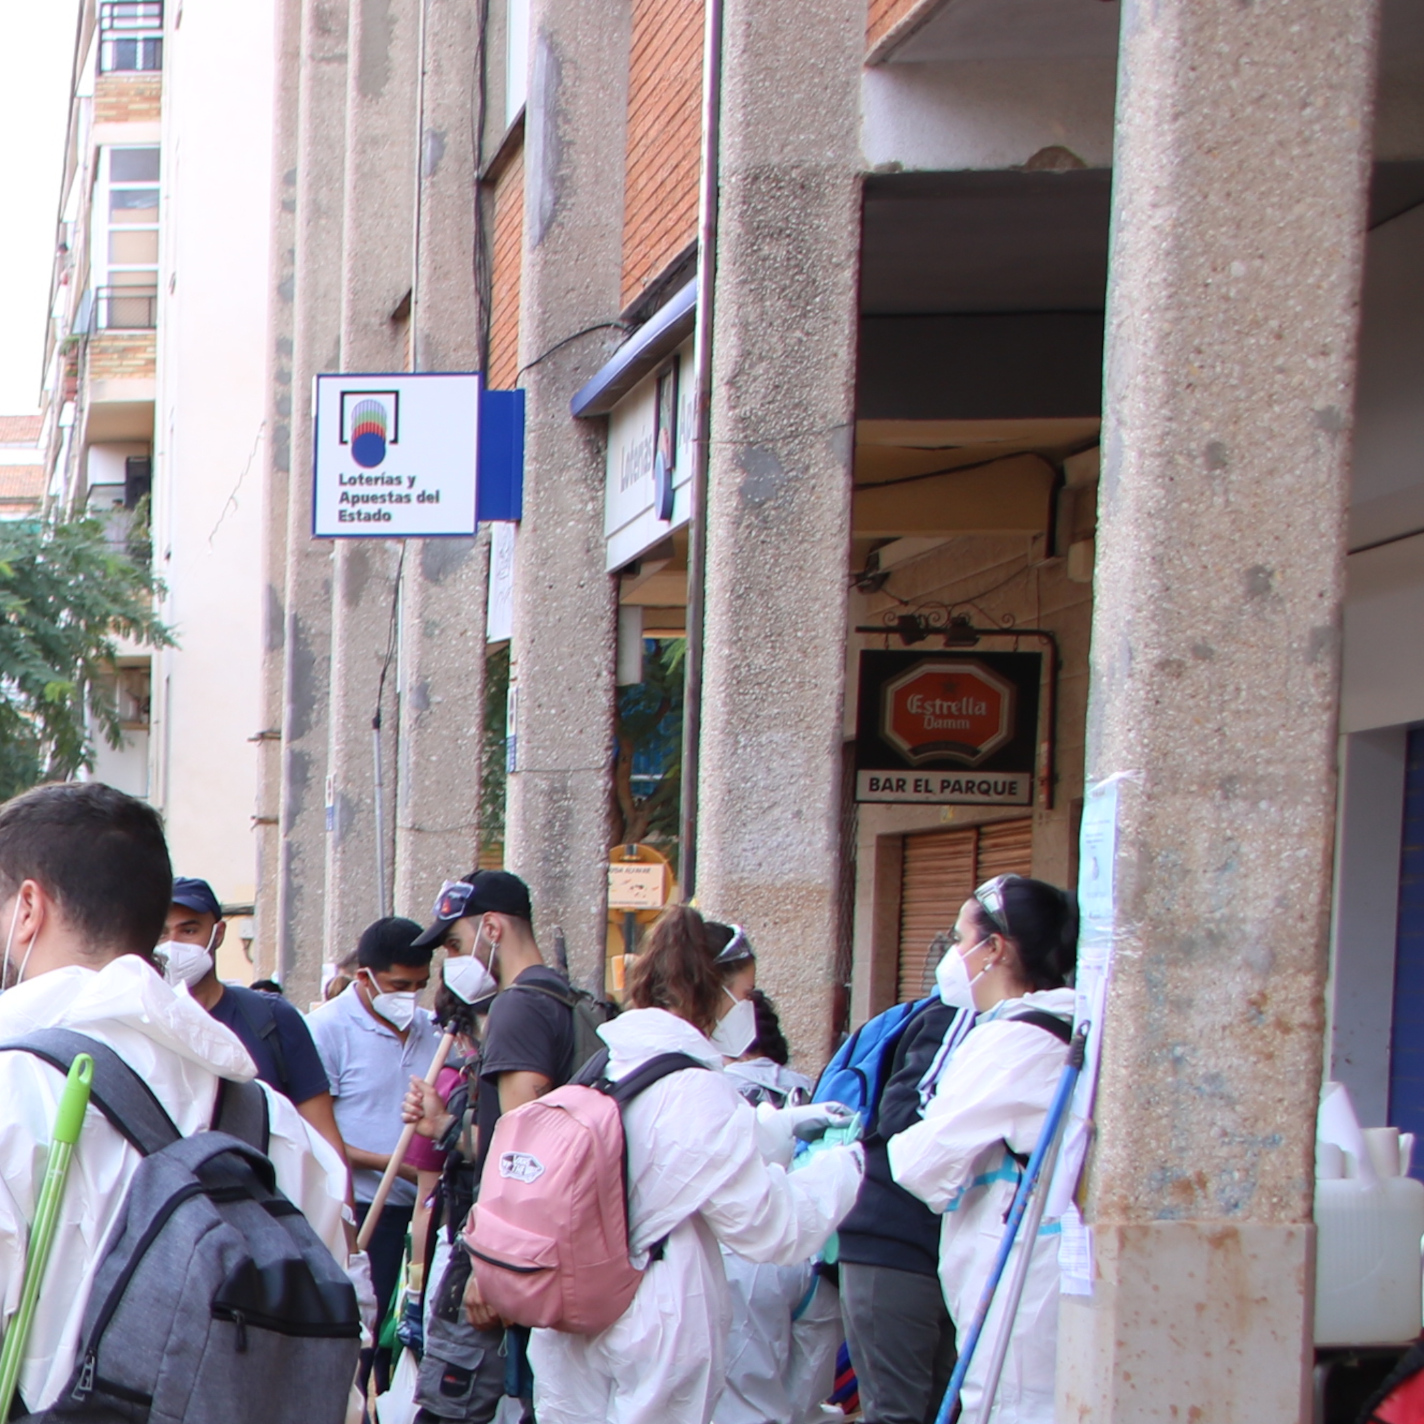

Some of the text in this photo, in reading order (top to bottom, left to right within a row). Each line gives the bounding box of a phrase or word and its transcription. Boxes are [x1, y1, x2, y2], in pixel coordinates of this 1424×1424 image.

[338, 471, 416, 488] Loterías y
[338, 490, 440, 508] Apuestas del
[338, 509, 392, 523] Estado
[907, 692, 988, 716] Estrella
[922, 715, 971, 730] Damm
[868, 776, 1018, 796] BAR EL PARQUE
